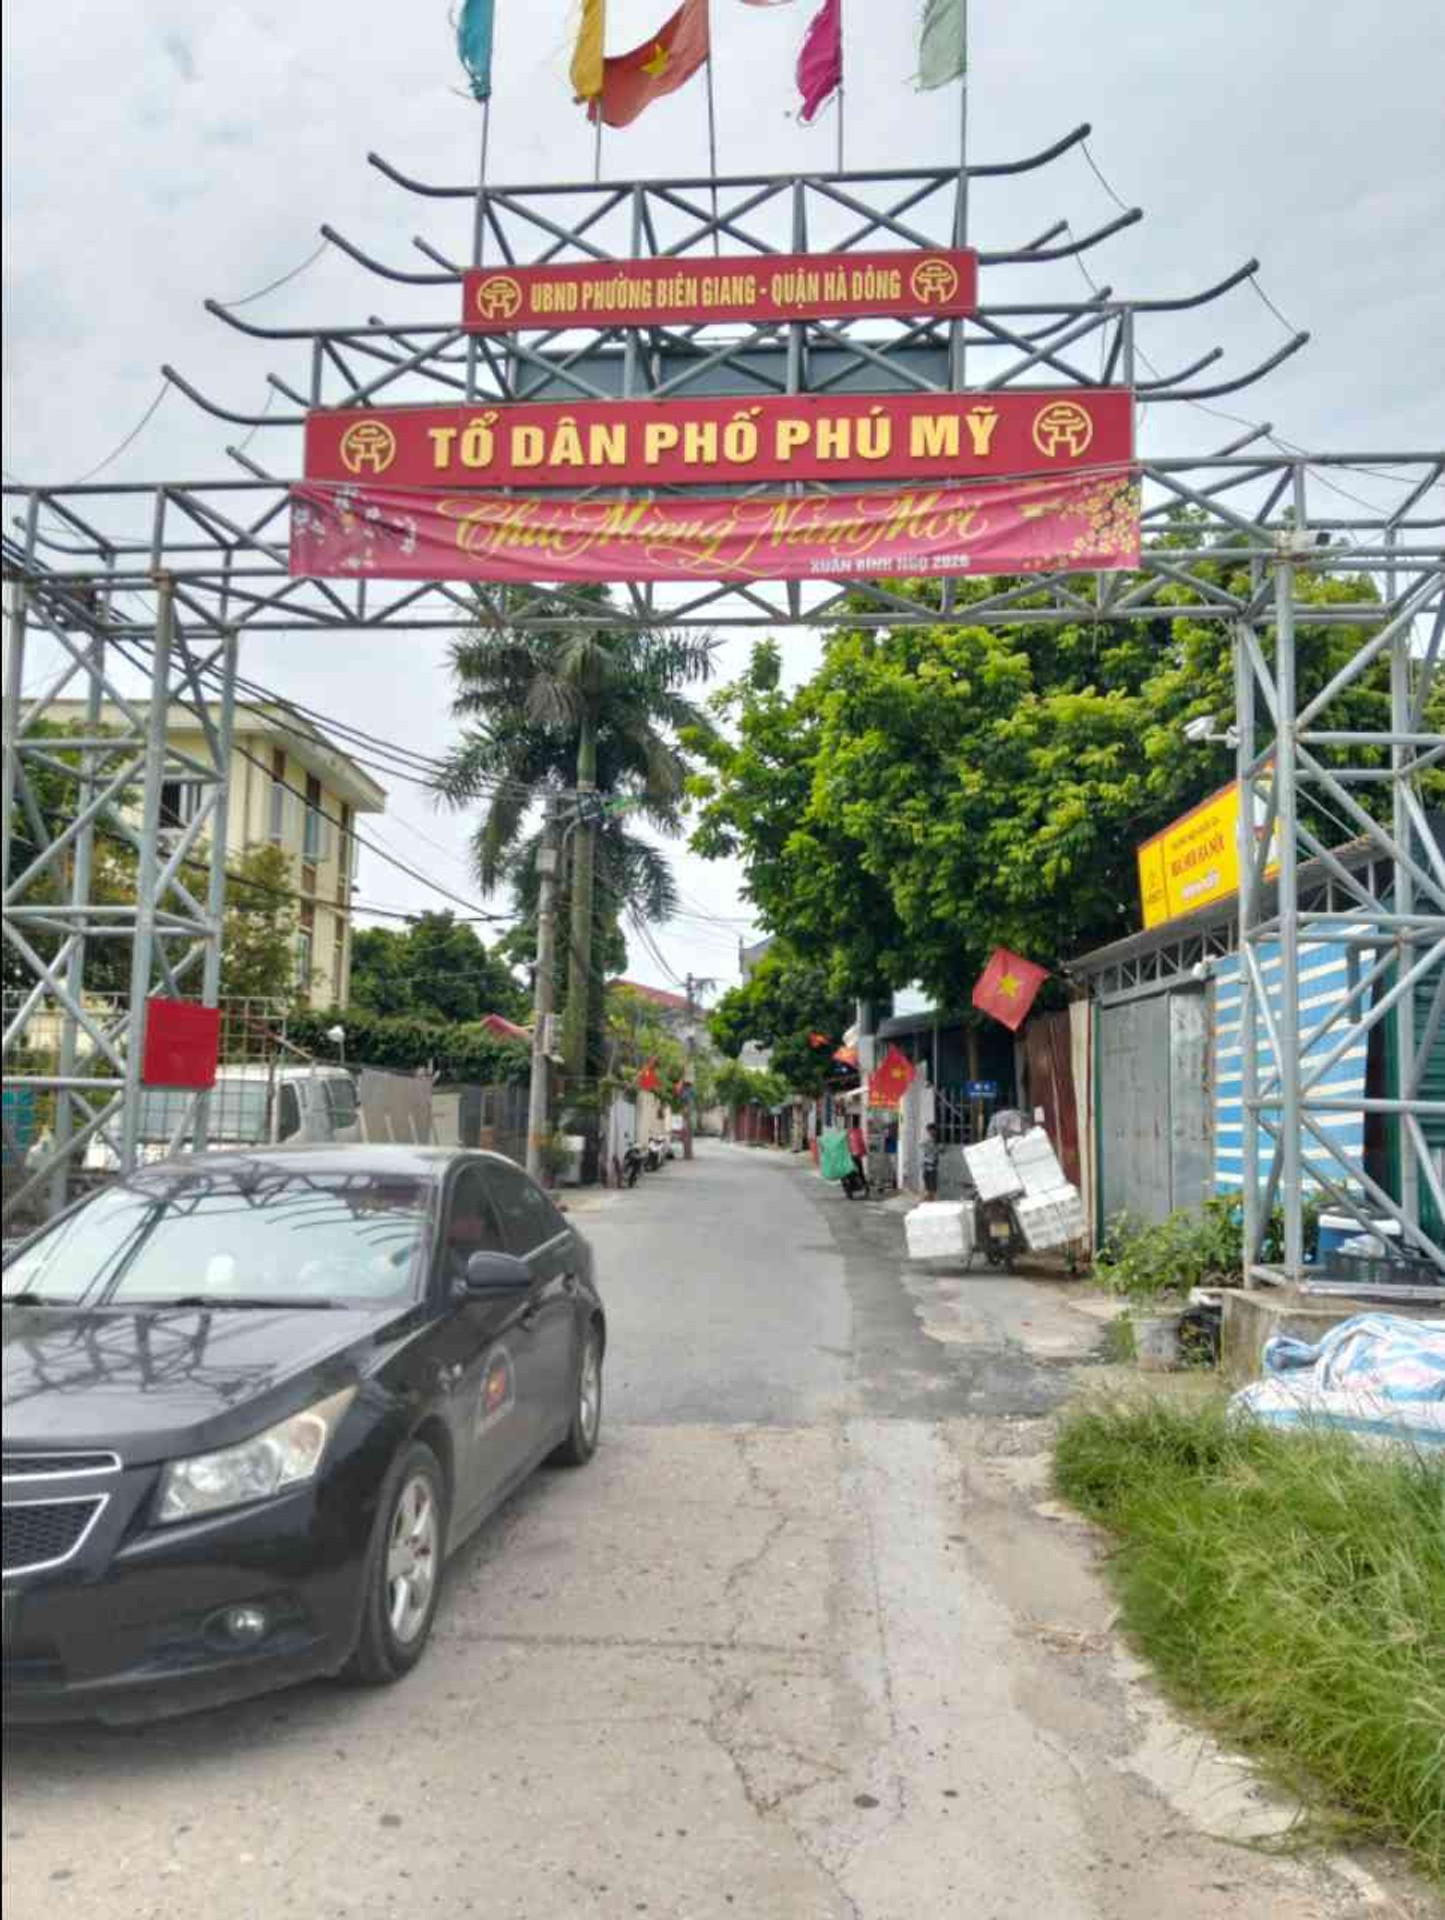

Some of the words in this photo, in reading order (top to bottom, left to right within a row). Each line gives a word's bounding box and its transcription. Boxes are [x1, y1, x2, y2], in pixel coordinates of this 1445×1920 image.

[530, 281, 578, 313] UBND
[701, 273, 757, 307] GIANG
[771, 266, 819, 310] QUẬN
[823, 264, 848, 301] HÀ
[428, 410, 499, 469] TỔ
[511, 416, 627, 468] DÂN
[644, 405, 763, 465] PHỐ
[775, 405, 892, 461] PHÚ
[909, 405, 999, 458] MỸ
